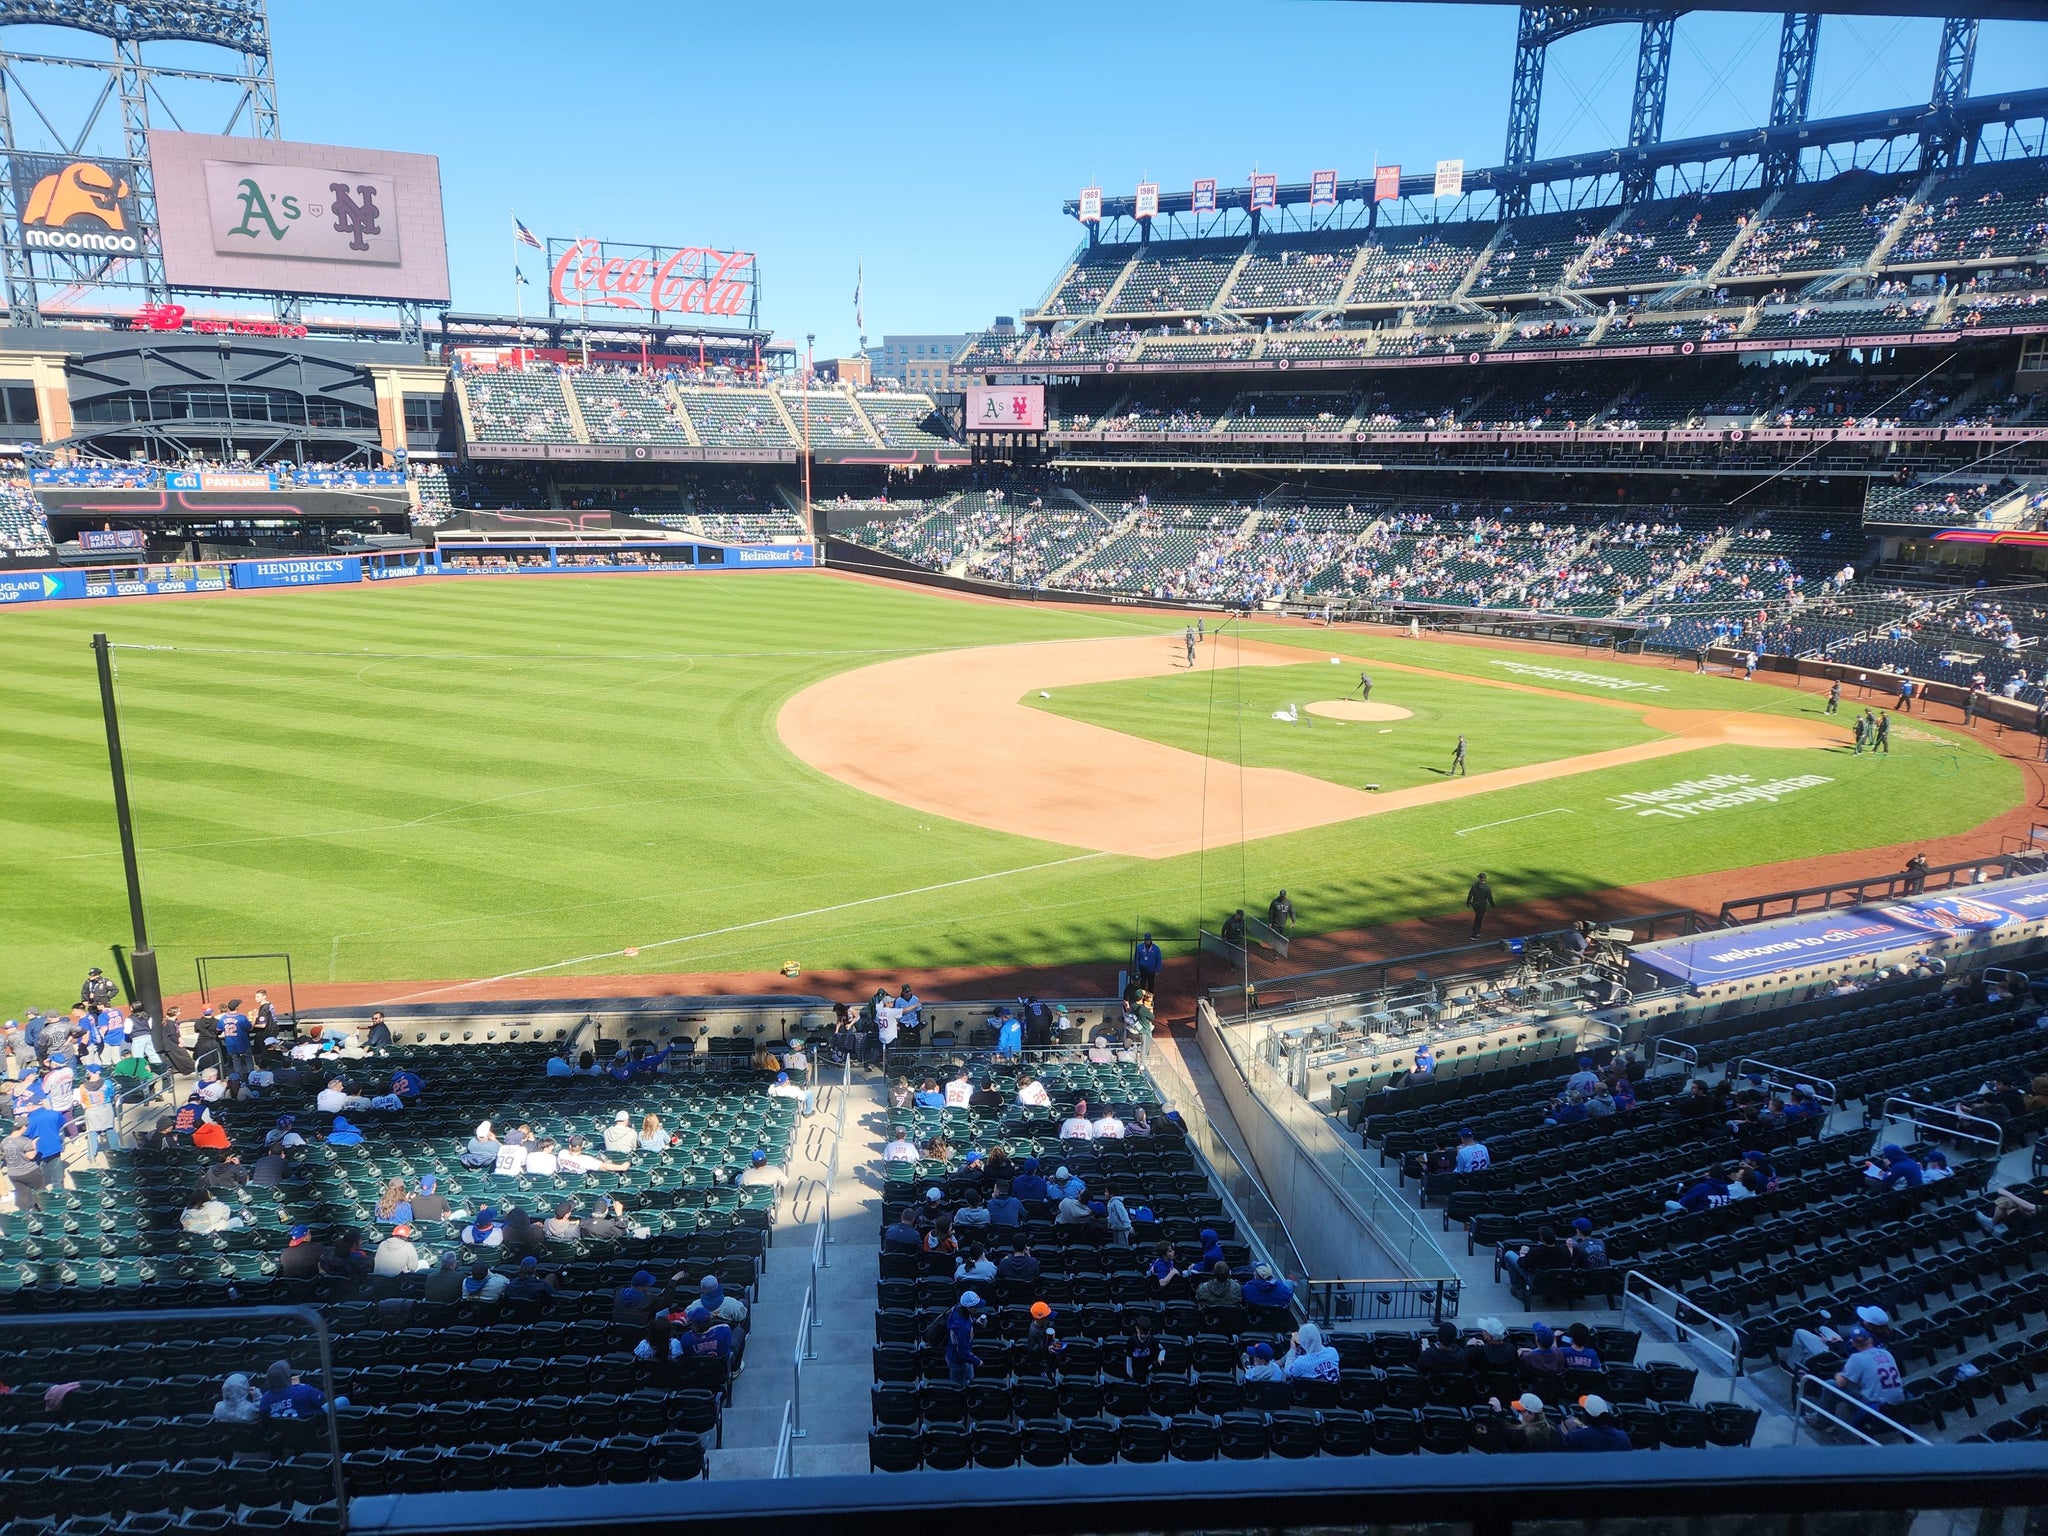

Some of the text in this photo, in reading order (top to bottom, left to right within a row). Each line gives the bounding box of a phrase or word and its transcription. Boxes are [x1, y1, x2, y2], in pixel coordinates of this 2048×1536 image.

[1084, 191, 1099, 199] 1969
[329, 182, 381, 251] NY
[25, 230, 136, 252] moomoo
[192, 319, 308, 337] new balance
[205, 478, 266, 487] PAVILION
[90, 540, 116, 548] RAFFLE
[15, 548, 50, 557] HubSpot
[740, 550, 790, 561] Heineken
[257, 560, 344, 575] HENDRICK'S
[389, 567, 418, 577] DUNKIN'
[424, 566, 438, 574] 370
[117, 584, 147, 592] GOYA
[157, 581, 186, 590] GOYA
[196, 579, 224, 588] GOYA
[86, 586, 108, 596] 380
[1926, 904, 2002, 929] Mets
[1709, 937, 1797, 964] welcome
[1797, 932, 1820, 947] to
[108, 1016, 123, 1029] 22
[224, 1024, 238, 1036] 12
[60, 1081, 72, 1096] 17
[896, 1096, 904, 1108] 7
[949, 1090, 964, 1103] 26
[1314, 1361, 1332, 1375] SOTO
[1877, 1366, 1901, 1389] 22
